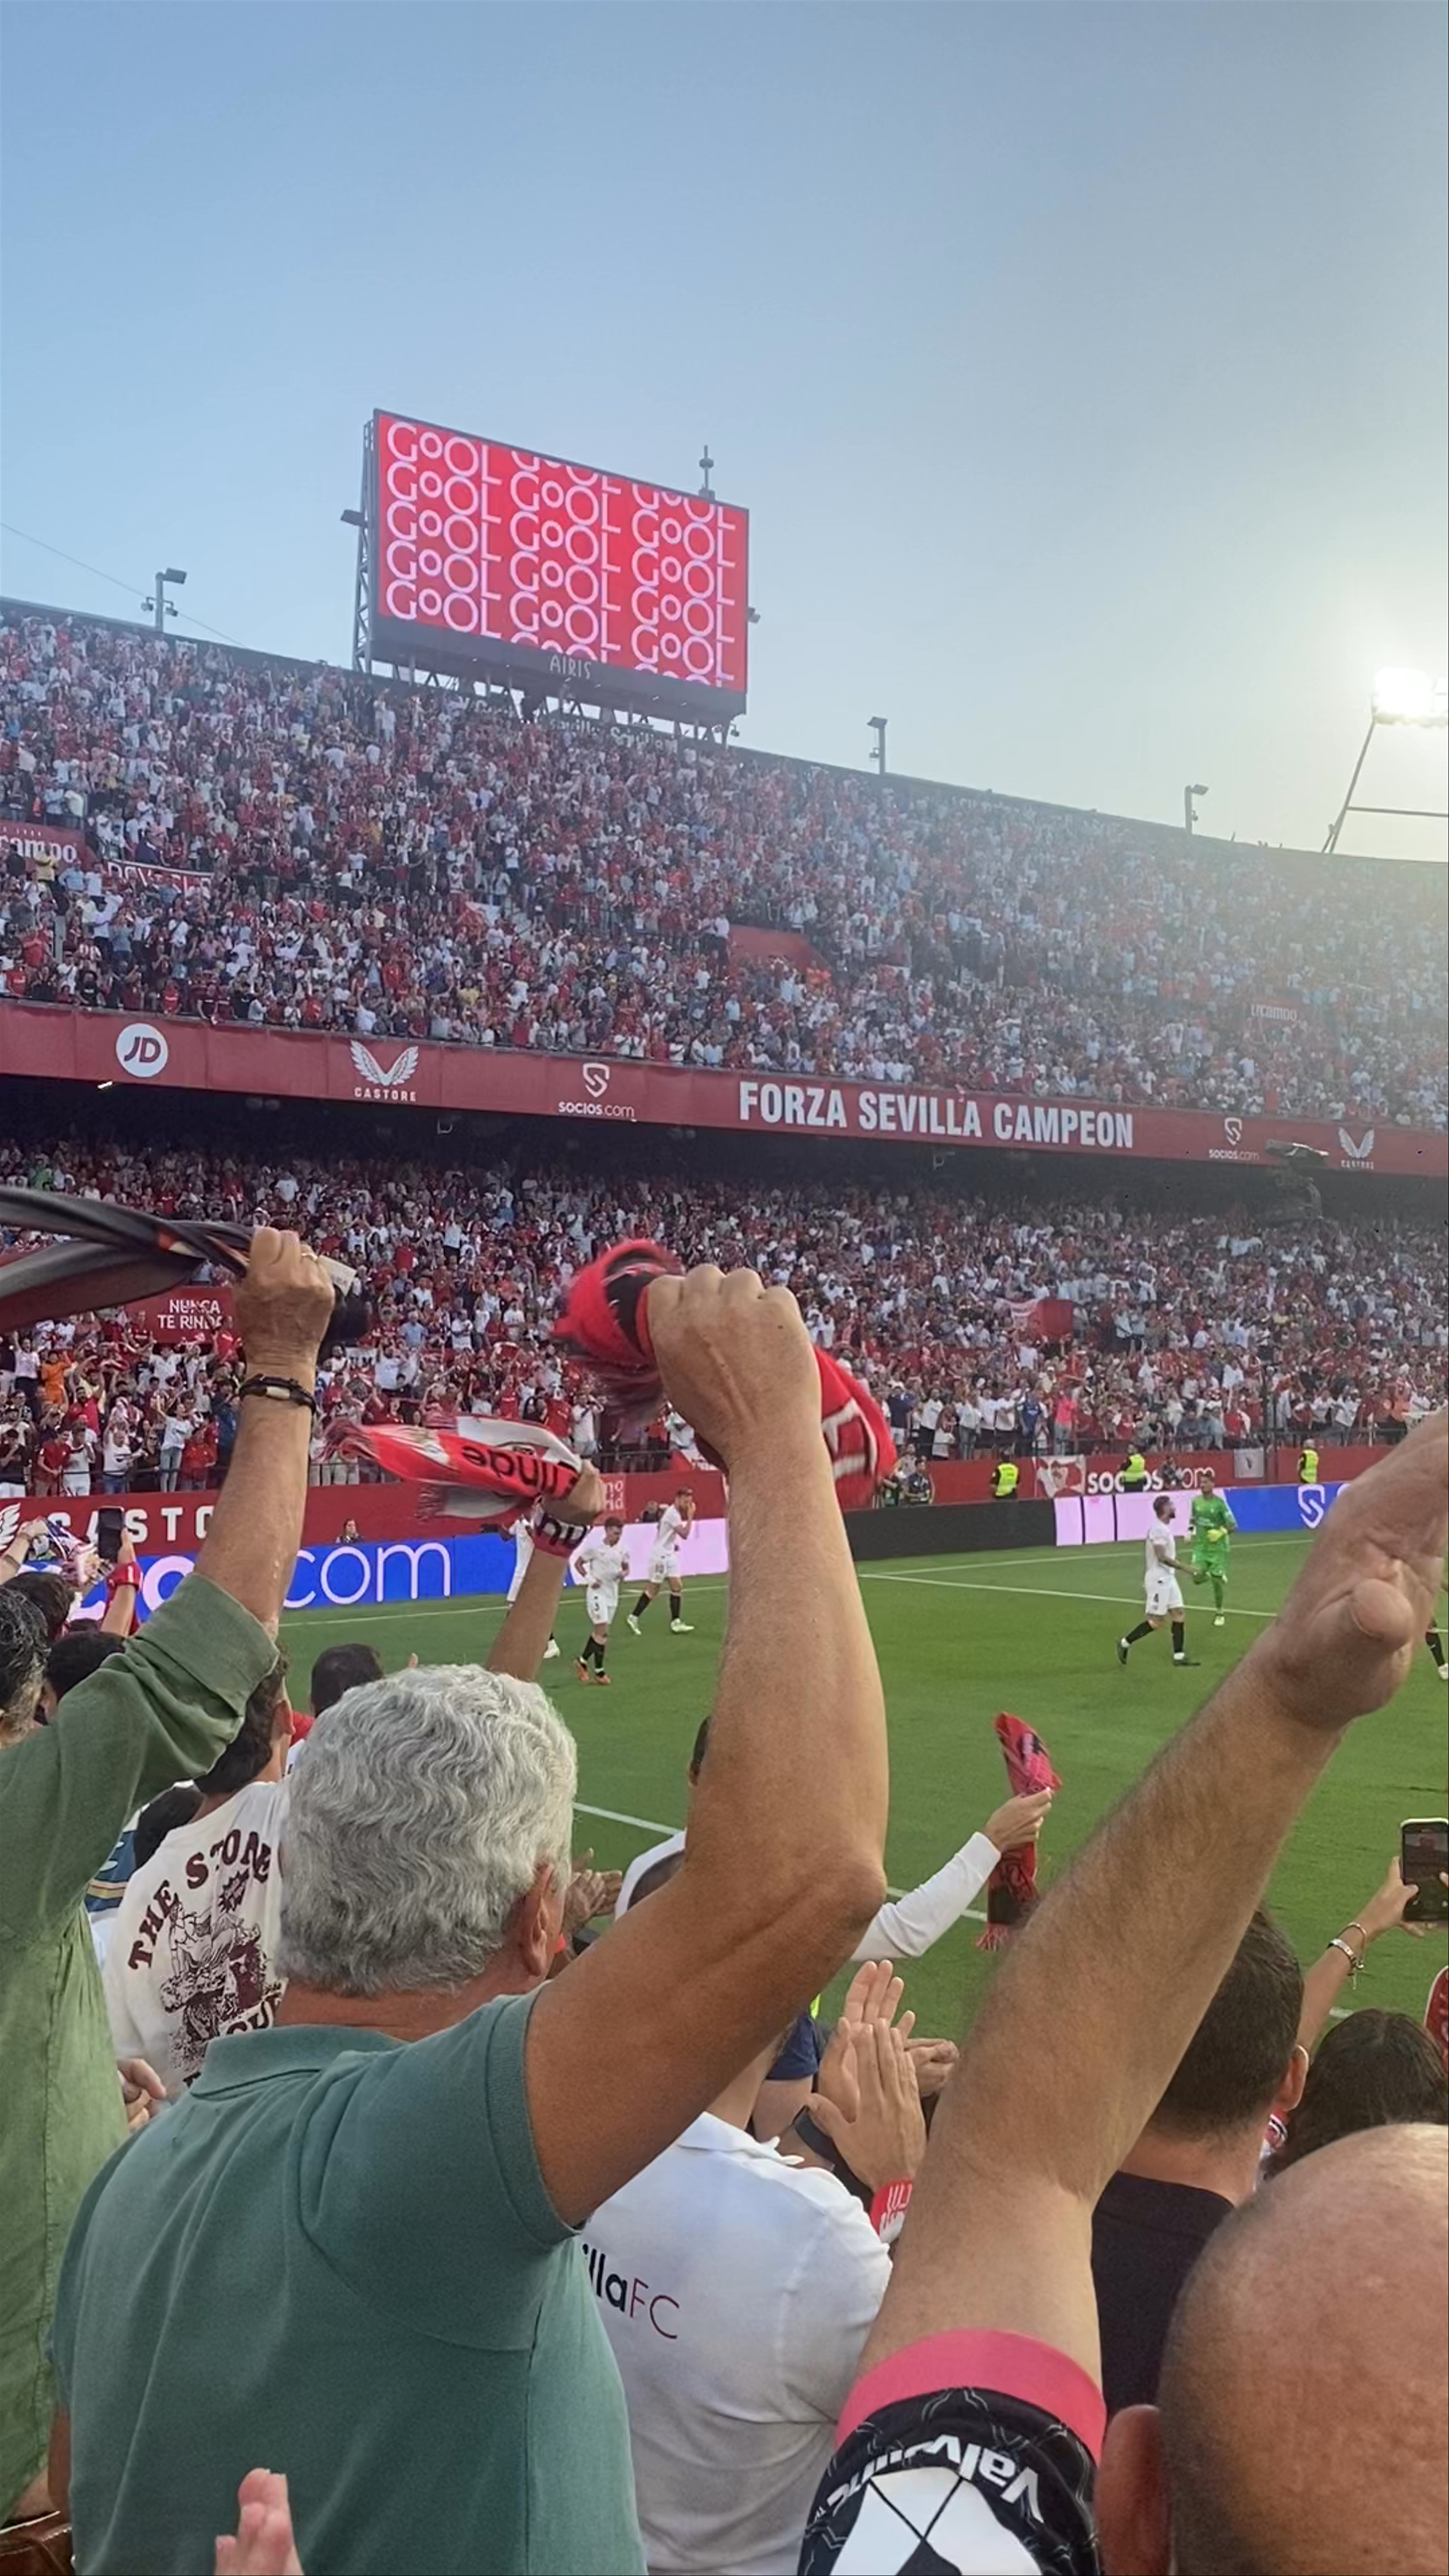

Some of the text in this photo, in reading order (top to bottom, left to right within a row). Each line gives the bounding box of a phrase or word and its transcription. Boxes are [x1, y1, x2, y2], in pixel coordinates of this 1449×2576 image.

[124, 1036, 161, 1063] JD
[354, 1087, 416, 1101] CASTORE
[740, 1081, 1133, 1149] FORZA SEVILLA CAMPEON
[170, 1299, 220, 1314] NUNCA
[157, 1314, 175, 1329] TE
[128, 1879, 179, 1970] THE
